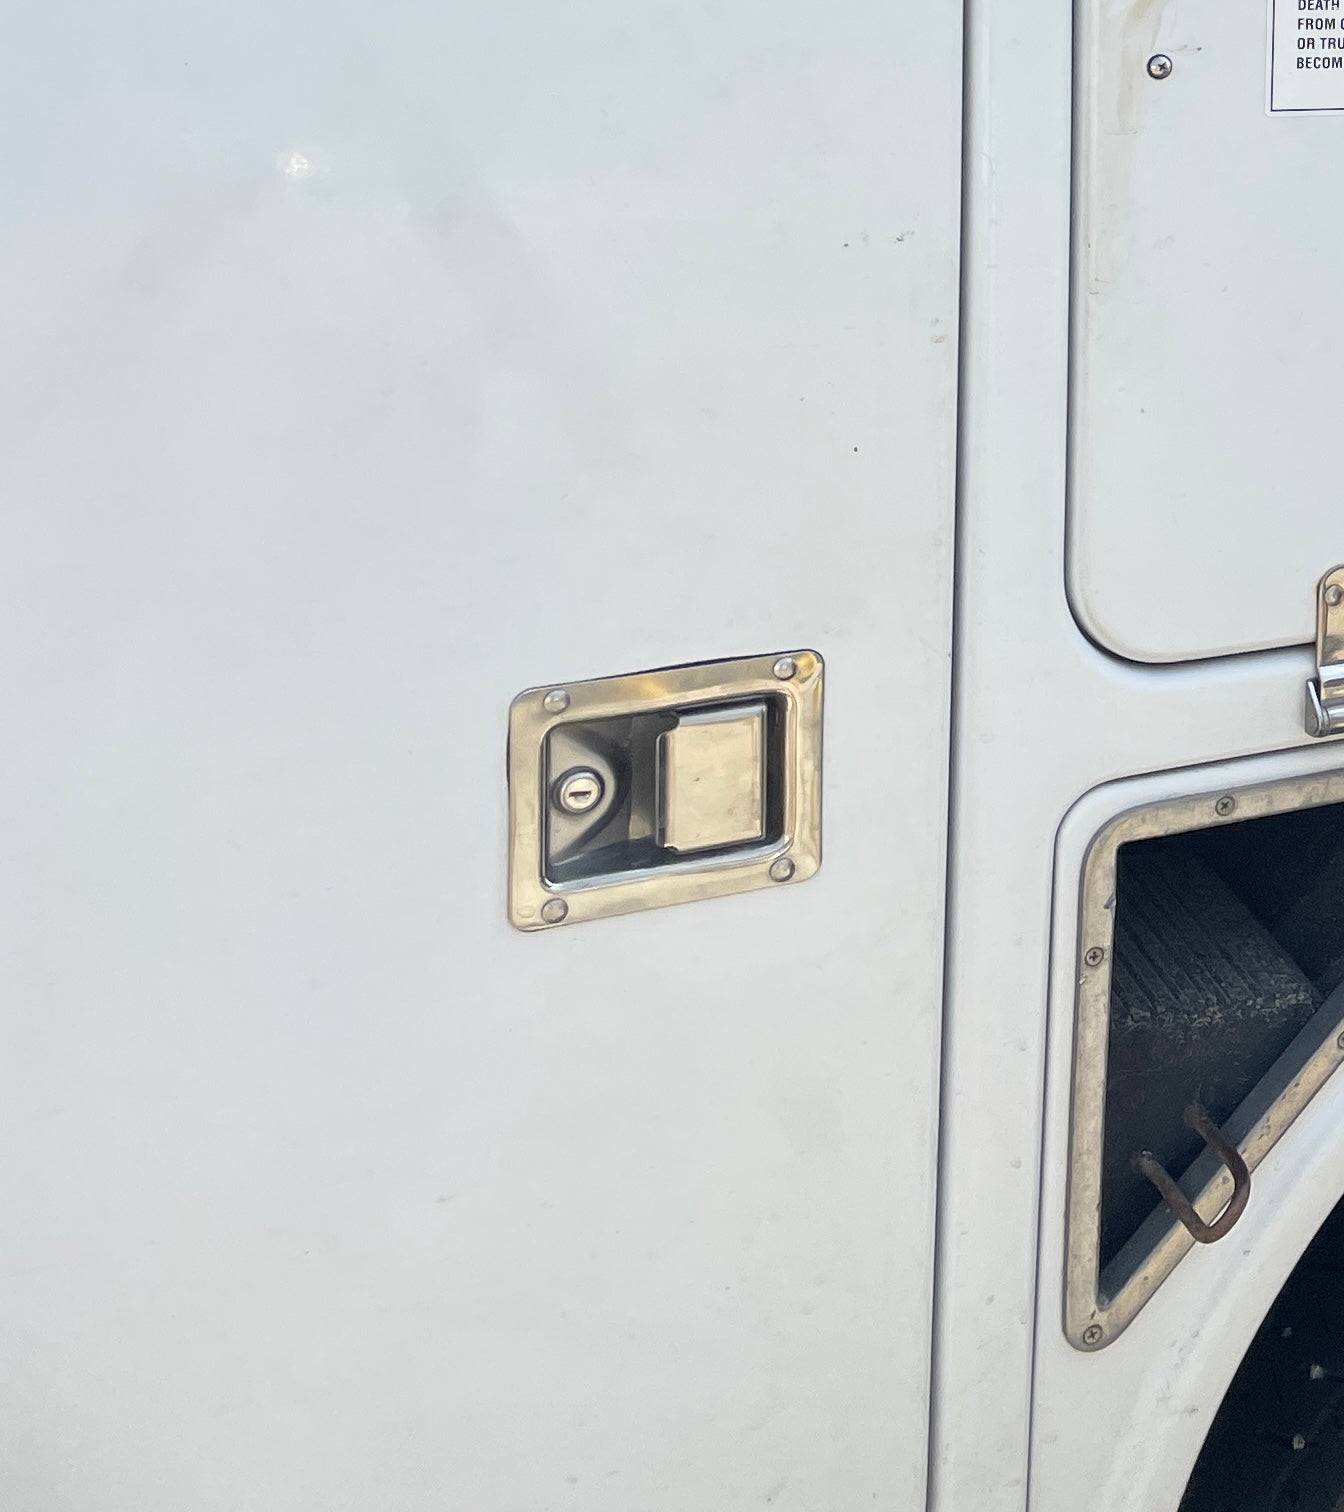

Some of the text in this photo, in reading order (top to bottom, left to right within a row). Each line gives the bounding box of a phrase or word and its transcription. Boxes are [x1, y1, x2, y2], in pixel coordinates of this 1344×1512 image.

[1298, 0, 1339, 11] DEATH
[1298, 18, 1336, 30] FROM
[1297, 37, 1315, 50] OR
